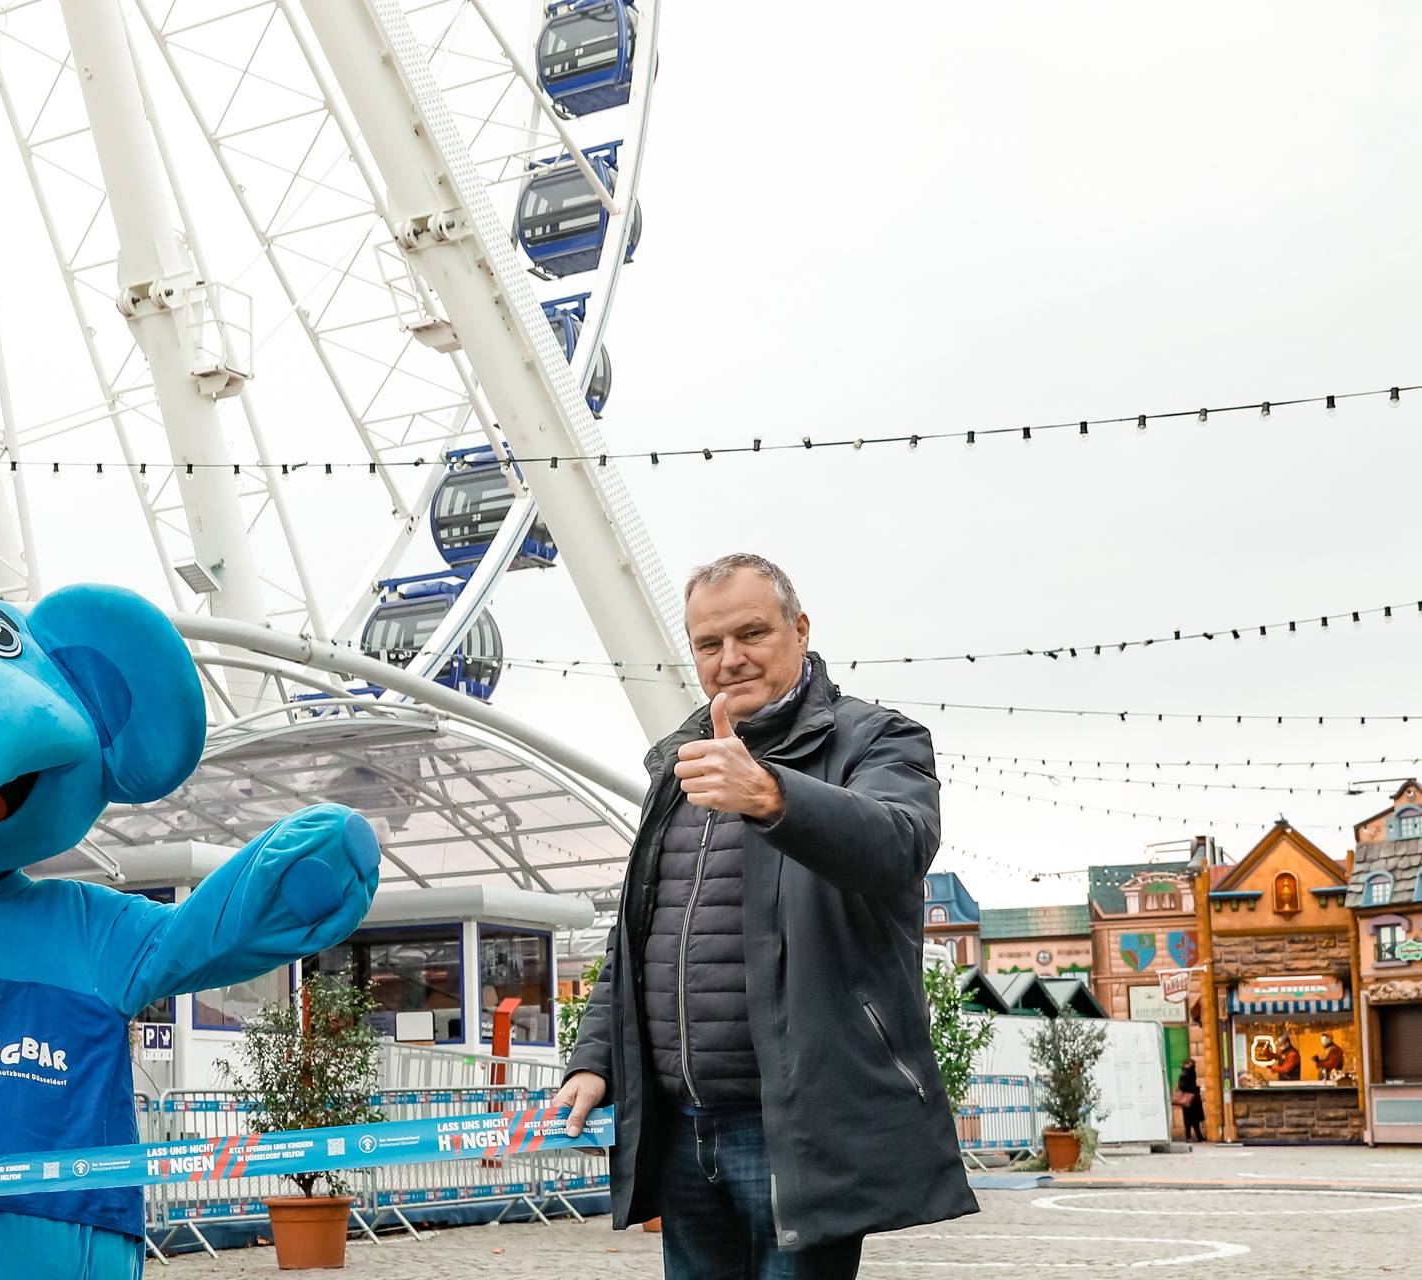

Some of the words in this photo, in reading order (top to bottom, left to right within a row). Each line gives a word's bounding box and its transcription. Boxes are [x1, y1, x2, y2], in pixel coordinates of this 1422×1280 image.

[145, 1028, 156, 1046] P
[438, 1123, 459, 1132] LASS
[462, 1122, 478, 1130] UNS
[481, 1118, 510, 1128] NICHT
[147, 1148, 168, 1158] LASS
[170, 1146, 187, 1156] UNS
[190, 1143, 214, 1153] NICHT
